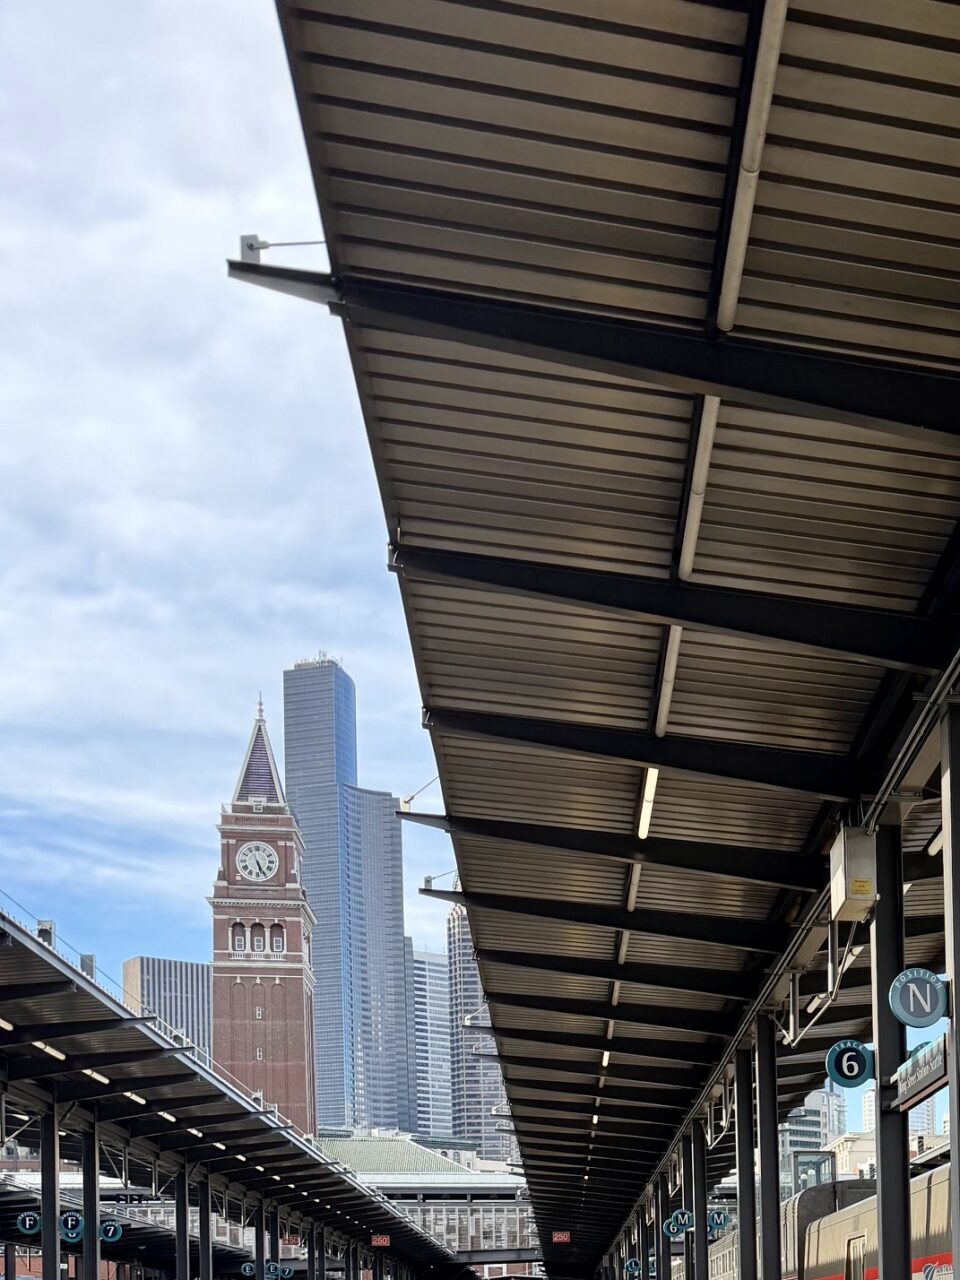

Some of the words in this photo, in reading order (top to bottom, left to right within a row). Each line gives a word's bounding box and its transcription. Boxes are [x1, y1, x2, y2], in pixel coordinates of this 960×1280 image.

[895, 969, 943, 989] POSITION
[907, 983, 931, 1012] N
[835, 1041, 864, 1051] TRACK
[842, 1052, 859, 1076] 6
[25, 1217, 34, 1229] F
[67, 1217, 76, 1229] F
[678, 1213, 689, 1225] M
[713, 1213, 724, 1224] M
[106, 1226, 115, 1237] 7
